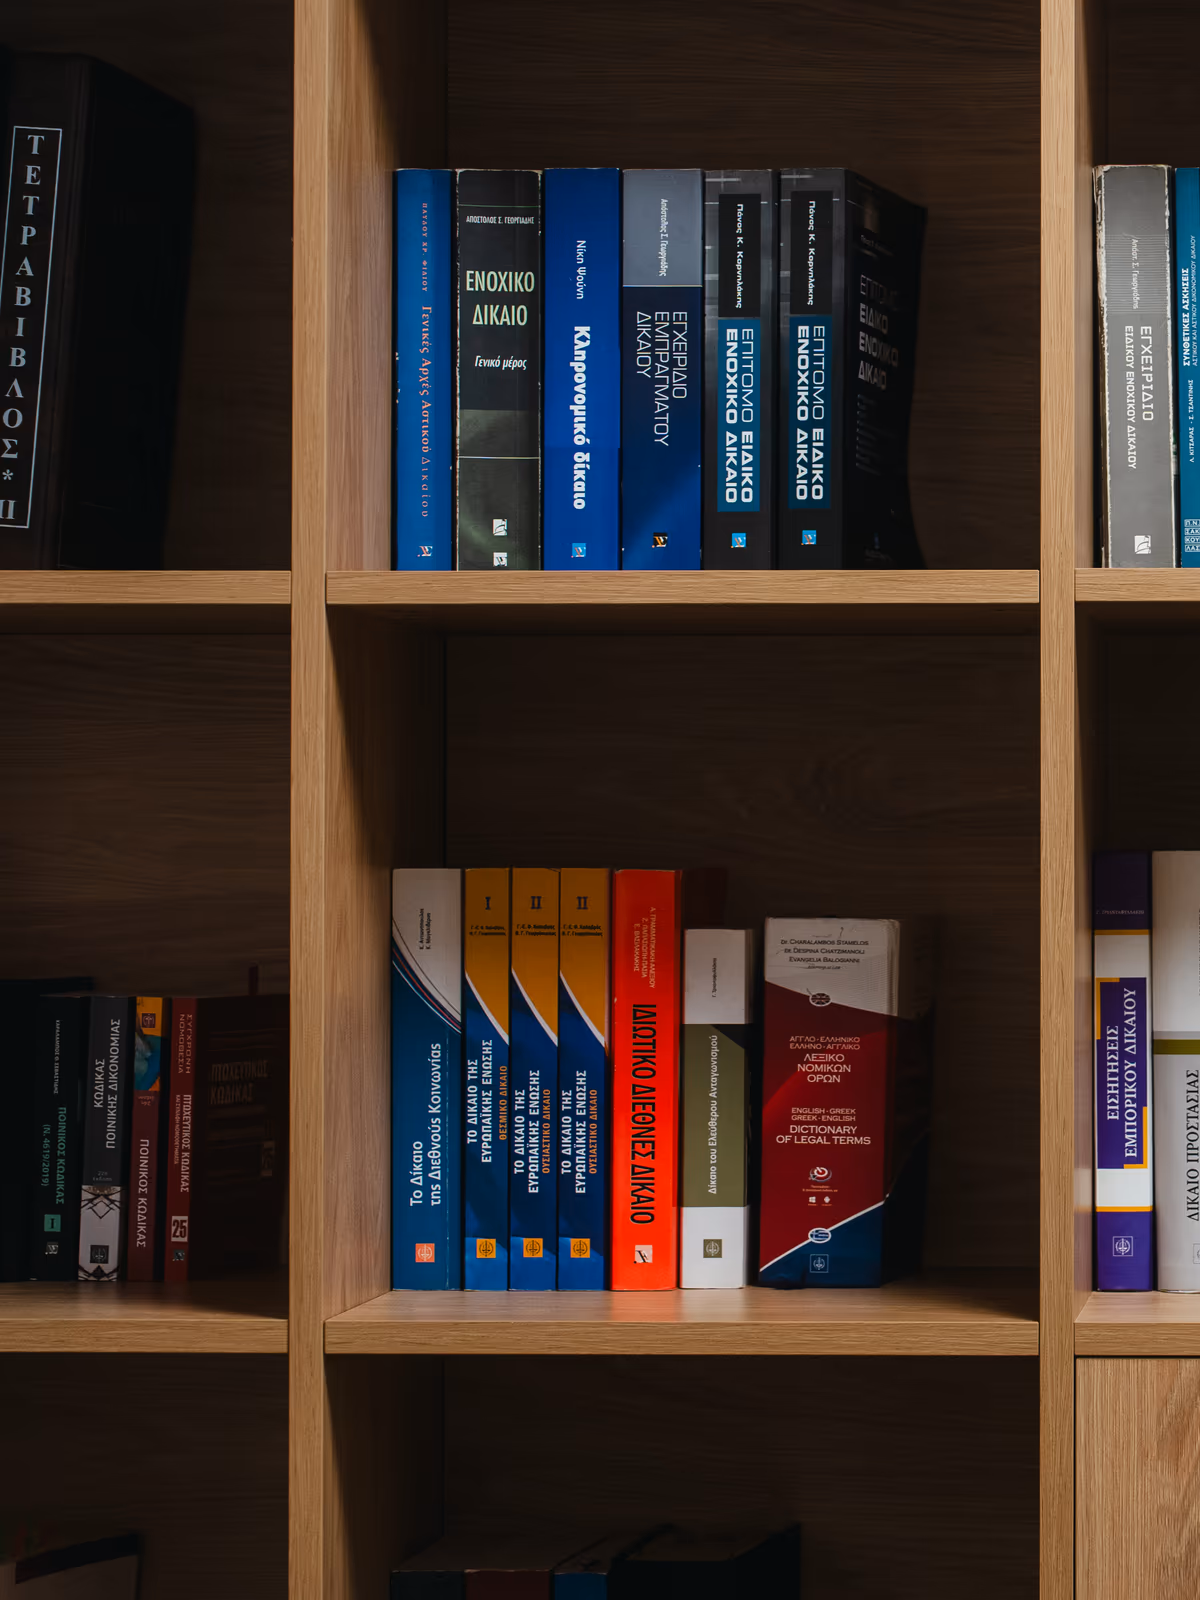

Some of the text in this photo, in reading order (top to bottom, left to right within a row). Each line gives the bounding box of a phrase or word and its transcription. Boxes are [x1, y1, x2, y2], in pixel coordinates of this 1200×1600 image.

[2, 135, 46, 459] ΤΕΤΡΑΒΙΒΛΟΣ
[466, 270, 535, 292] ΕΝΟΧΙΚΟ
[472, 304, 528, 326] ΔΙΚΑΙΟ
[474, 355, 527, 371] Γενικό μέρος
[637, 312, 651, 378] ΔΙΚΑΙΟΥ
[654, 312, 669, 446] ΕΜΠΡΑΓΜΑΤΟΥ
[672, 312, 687, 399] ΕΓΧΕΙΡΙΔΙΟ
[1140, 326, 1153, 421] ΕΓΧΕΙΡΙΔΙΟ
[1182, 313, 1190, 366] ΣΥΝΘΕΤΙΚΕΣ
[570, 325, 591, 510] Κληρονομικό δίκαιο
[725, 328, 738, 503] ΕΝΟΧΙΚΟ ΔΙΚΑΙΟ
[741, 328, 753, 503] ΕΠΙΤΟΜΟ ΕΙΔΙΚΟ
[796, 325, 809, 500] ΕΝΟΧΙΚΟ ΔΙΚΑΙΟ
[811, 325, 824, 500] ΕΠΙΤΟΜΟ ΕΙΔΙΚΟ
[1125, 326, 1136, 469] ΕΙΔΙΚΟΥ ΕΝΟΧΙΚΟΥ ΔΙΚΑΙΟΥ
[93, 1059, 105, 1108] ΚΩΔΙΚΑΣ
[106, 1019, 121, 1149] ΠΟΙΝΙΚΗΣ ΔΙΚΟΝΟΜΙΑΣ
[467, 1059, 478, 1144] ΤΟ ΔΙΚΑΙΟ ΤΗΣ
[480, 1039, 492, 1163] ΕΥΡΩΠΑΪΚΗΣ ΕΝΩΣΗΣ
[499, 1065, 507, 1140] ΘΕΣΜΙΚΟ ΔΙΚΑΙΟ
[797, 1064, 852, 1072] ΝΟΜΙΚΩΝ
[804, 1054, 845, 1062] ΛΕΞΙΚΟ
[807, 1074, 840, 1083] ΟΡΩΝ
[1107, 1026, 1120, 1120] ΕΙΣΗΓΗΣΕΙΣ
[1124, 988, 1137, 1157] ΕΜΠΟΡΙΚΟΥ ΔΙΚΑΙΟΥ
[55, 1107, 67, 1205] ΠΟΙΝΙΚΟΣ ΚΩΔΙΚΑΣ
[180, 1095, 192, 1193] ΠΤΩΧΕΥΤΙΚΟΣ ΚΩΔΙΚΑΣ
[427, 1043, 441, 1206] της Διεθνούς Κοινωνίας
[514, 1089, 525, 1174] ΤΟ ΔΙΚΑΙΟ ΤΗΣ
[527, 1070, 540, 1193] ΕΥΡΩΠΑΪΚΗΣ ΕΝΩΣΗΣ
[542, 1089, 550, 1174] ΟΥΣΙΑΣΤΙΚΟ ΔΙΚΑΙΟ
[561, 1090, 572, 1174] ΤΟ ΔΙΚΑΙΟ ΤΗΣ
[574, 1070, 587, 1194] ΕΥΡΩΠΑΪΚΗΣ ΕΝΩΣΗΣ
[589, 1089, 597, 1174] ΟΥΣΙΑΣΤΙΚΟ ΔΙΚΑΙΟ
[630, 1004, 656, 1224] ΙΔΙΩΤΙΚΟ ΔΙΕΘΝΕΣ ΔΙΚΑΙΟ
[776, 1135, 871, 1145] OF LEGAL TERMS
[790, 1125, 857, 1134] DICTIONARY
[1186, 1070, 1199, 1221] ΔΙΚΑΙΟ ΠΡΟΣΤΑΣΙΑΣ
[136, 1139, 149, 1247] ΠΟΙΝΙΚΟΣ ΚΩΔΙΚΑΣ
[409, 1141, 423, 1206] Το Δίκαιο
[172, 1220, 187, 1239] 25
